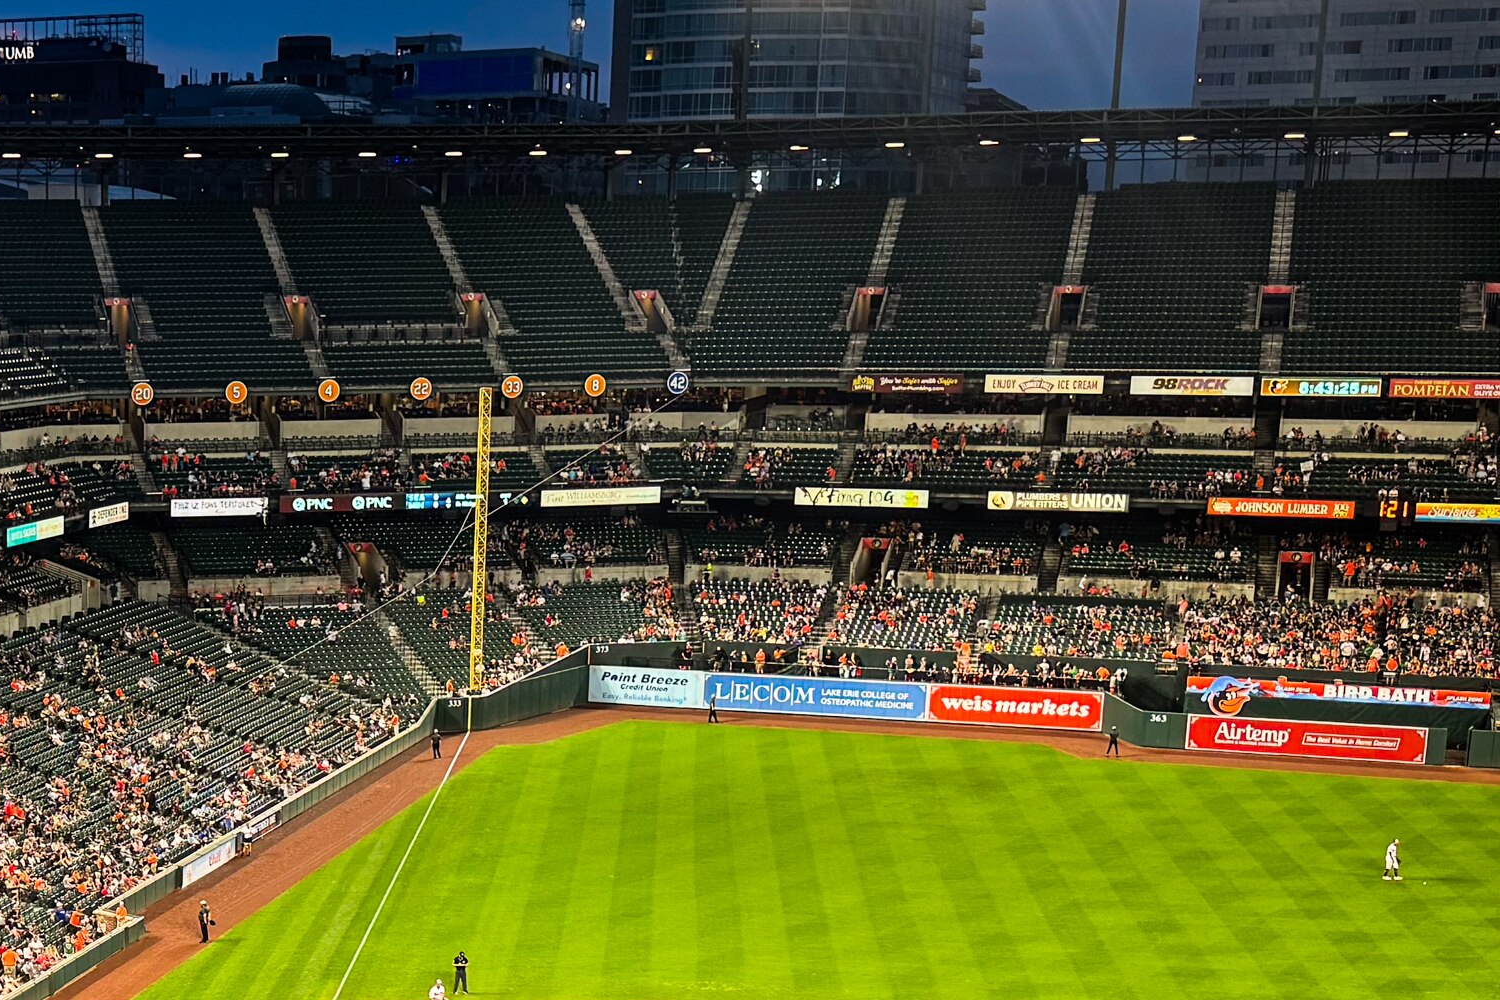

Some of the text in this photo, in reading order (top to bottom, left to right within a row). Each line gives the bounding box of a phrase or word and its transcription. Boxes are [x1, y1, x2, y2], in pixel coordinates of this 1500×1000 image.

[5, 46, 34, 60] UMB
[414, 382, 428, 395] 22
[506, 381, 520, 393] 33
[592, 379, 599, 391] 8
[671, 376, 685, 389] 42
[993, 379, 1016, 389] ENJOY
[1058, 380, 1069, 389] ICE
[1073, 380, 1098, 390] CREAM
[135, 388, 151, 401] 20
[233, 386, 240, 398] 5
[325, 385, 333, 396] 4
[1361, 384, 1378, 394] PM
[1394, 384, 1469, 396] POMPEIAN
[365, 496, 393, 510] PNC
[1016, 493, 1060, 501] PLUMBERS
[1071, 493, 1127, 508] UNION
[307, 497, 333, 511] PNC
[1015, 500, 1069, 509] PIPE FITTERS
[1235, 502, 1284, 514] JOHNSON
[1287, 503, 1328, 515] LUMBER
[1428, 506, 1477, 517] Surfside
[596, 646, 609, 654] 373
[641, 674, 689, 686] Breeze
[620, 683, 644, 691] Credit
[1323, 684, 1430, 702] BIRD BATH
[821, 688, 909, 700] LAKE ERIE COLLEGE OF
[820, 697, 914, 710] OSTEOPATHIC MEDICINE
[941, 695, 1090, 717] weis markets
[1150, 713, 1167, 723] 363
